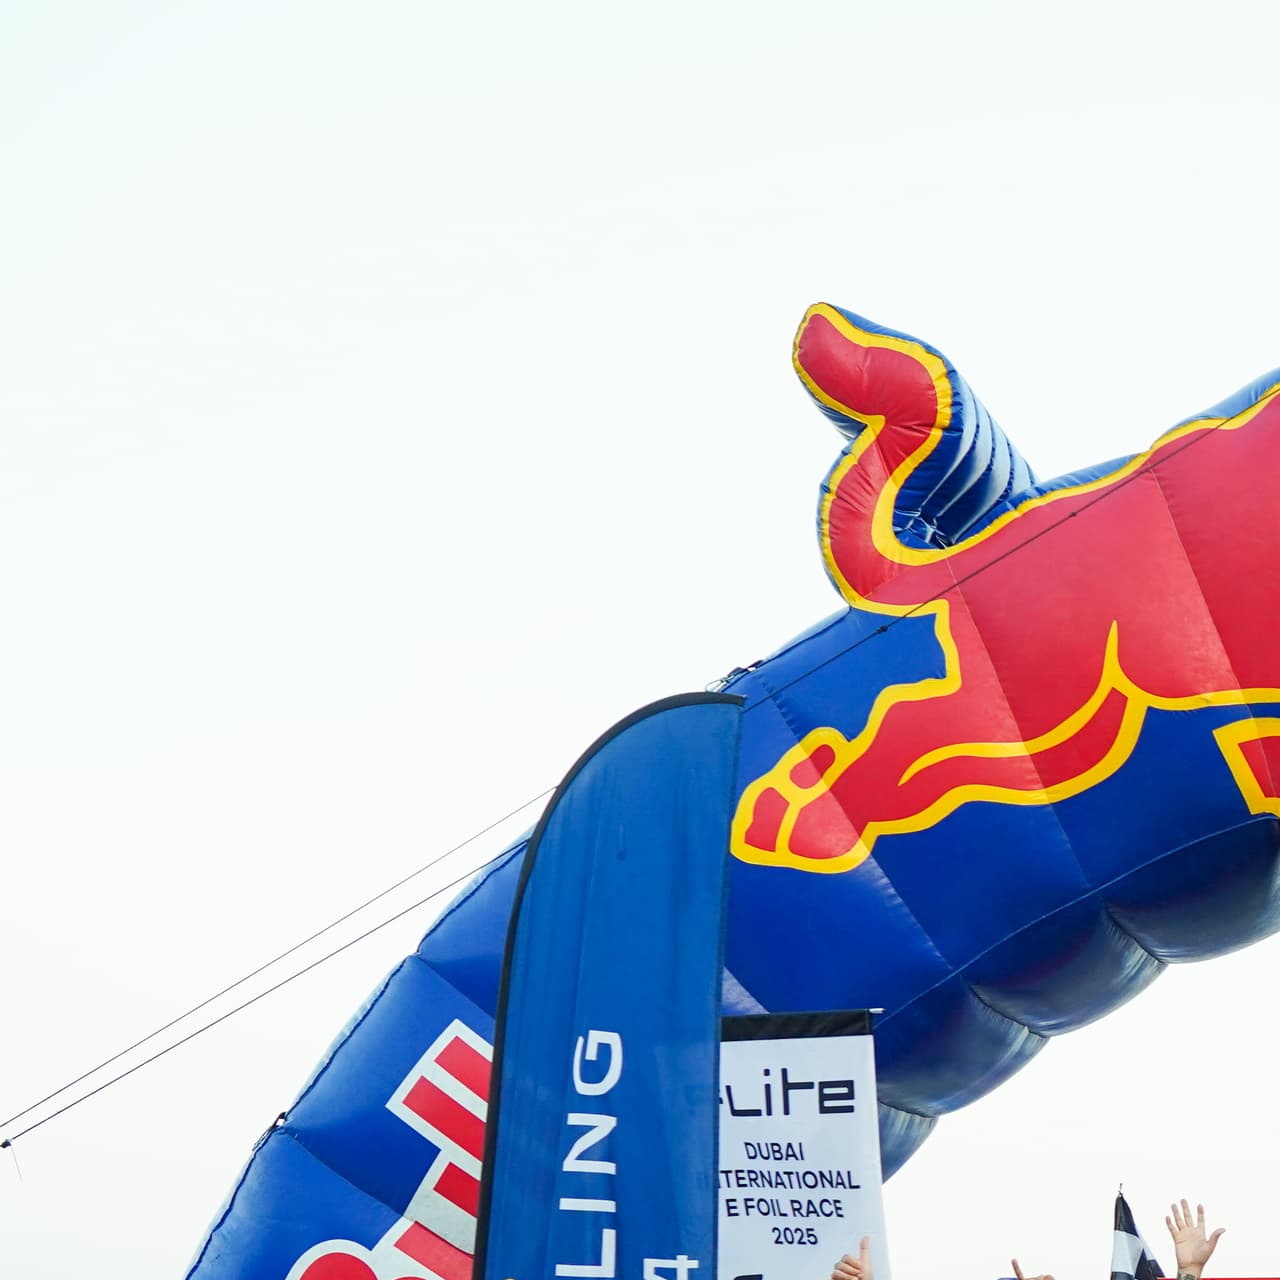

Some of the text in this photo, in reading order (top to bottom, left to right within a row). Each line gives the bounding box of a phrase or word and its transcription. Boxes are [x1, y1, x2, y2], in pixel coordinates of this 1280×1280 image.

[743, 1141, 806, 1162] DUBAI
[717, 1168, 861, 1191] TERNATIONAL
[725, 1198, 846, 1219] E FOIL RACE
[771, 1226, 819, 1246] 2025
